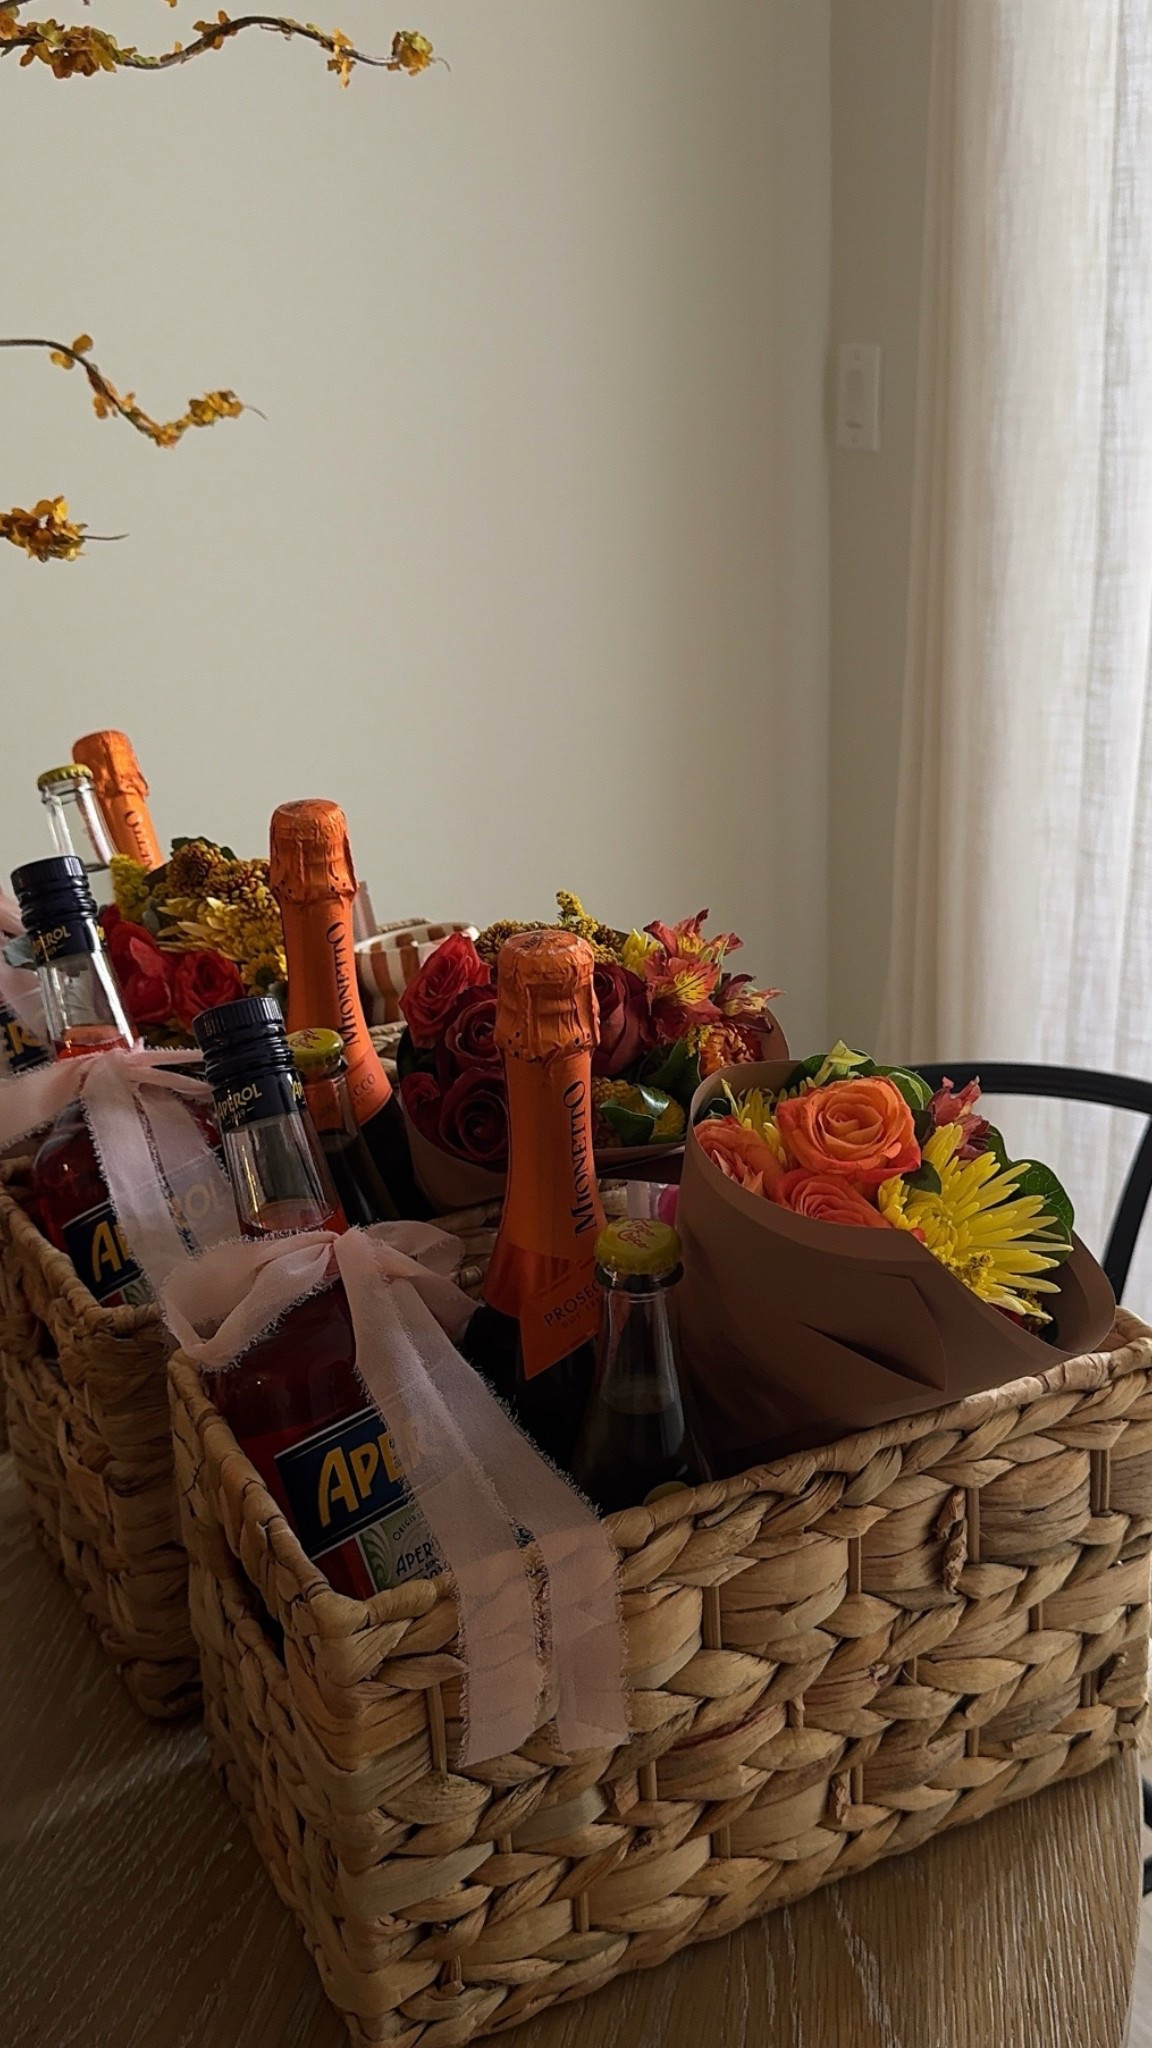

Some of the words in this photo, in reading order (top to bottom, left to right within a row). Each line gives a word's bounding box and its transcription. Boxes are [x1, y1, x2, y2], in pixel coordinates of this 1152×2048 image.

[326, 921, 360, 1047] MIONETTO
[563, 1080, 598, 1237] MIONETTO
[544, 1279, 600, 1327] PROSEC
[318, 1430, 403, 1529] APE
